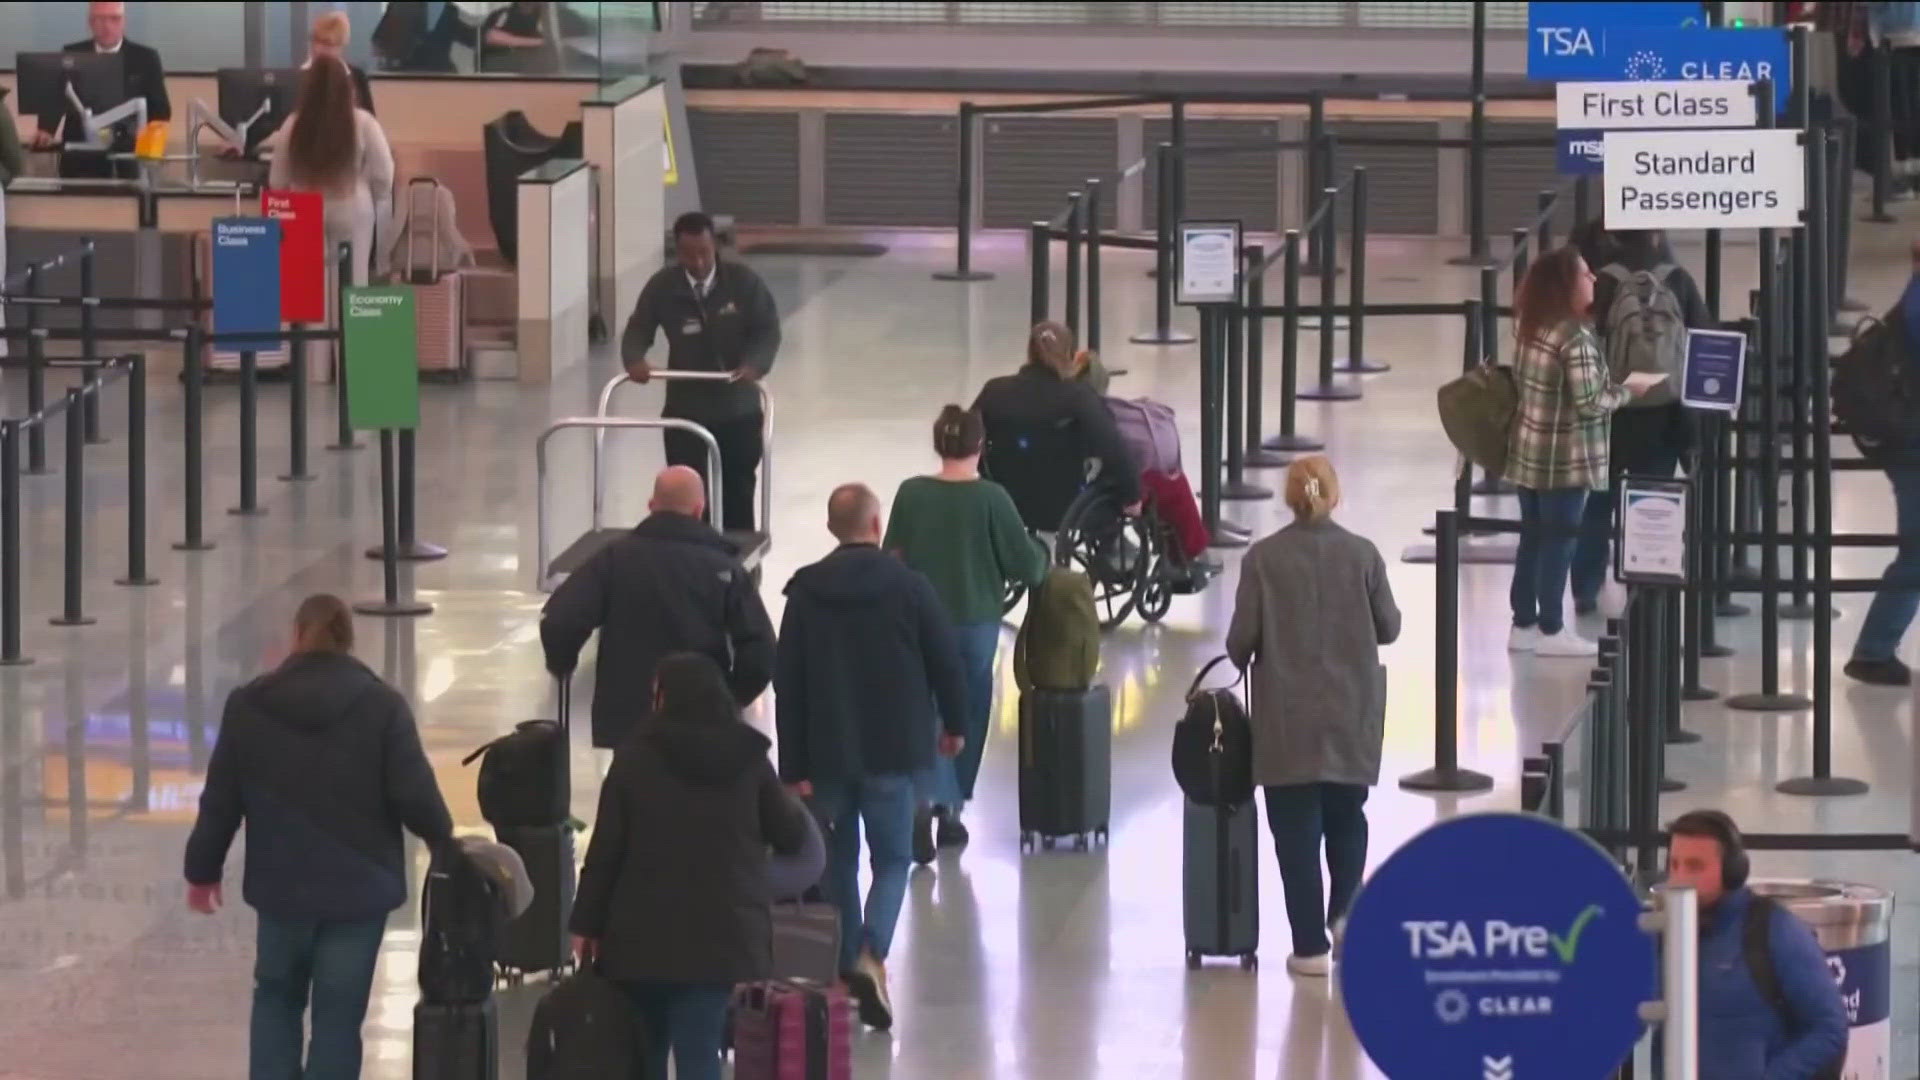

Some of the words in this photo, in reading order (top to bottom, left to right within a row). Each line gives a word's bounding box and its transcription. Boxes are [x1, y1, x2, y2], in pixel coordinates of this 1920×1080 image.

[1536, 27, 1594, 56] TSA
[1681, 61, 1772, 80] CLEAR
[1583, 92, 1644, 117] First
[1654, 91, 1729, 116] Class
[1635, 150, 1755, 176] Standard
[268, 197, 290, 208] First
[1621, 186, 1778, 215] Passengers
[218, 224, 266, 235] Business
[218, 236, 248, 246] Class
[350, 294, 403, 306] Economy
[350, 306, 381, 317] Class
[1402, 920, 1477, 958] TSA
[1485, 920, 1549, 957] Pre
[1478, 997, 1552, 1015] CLEAR
